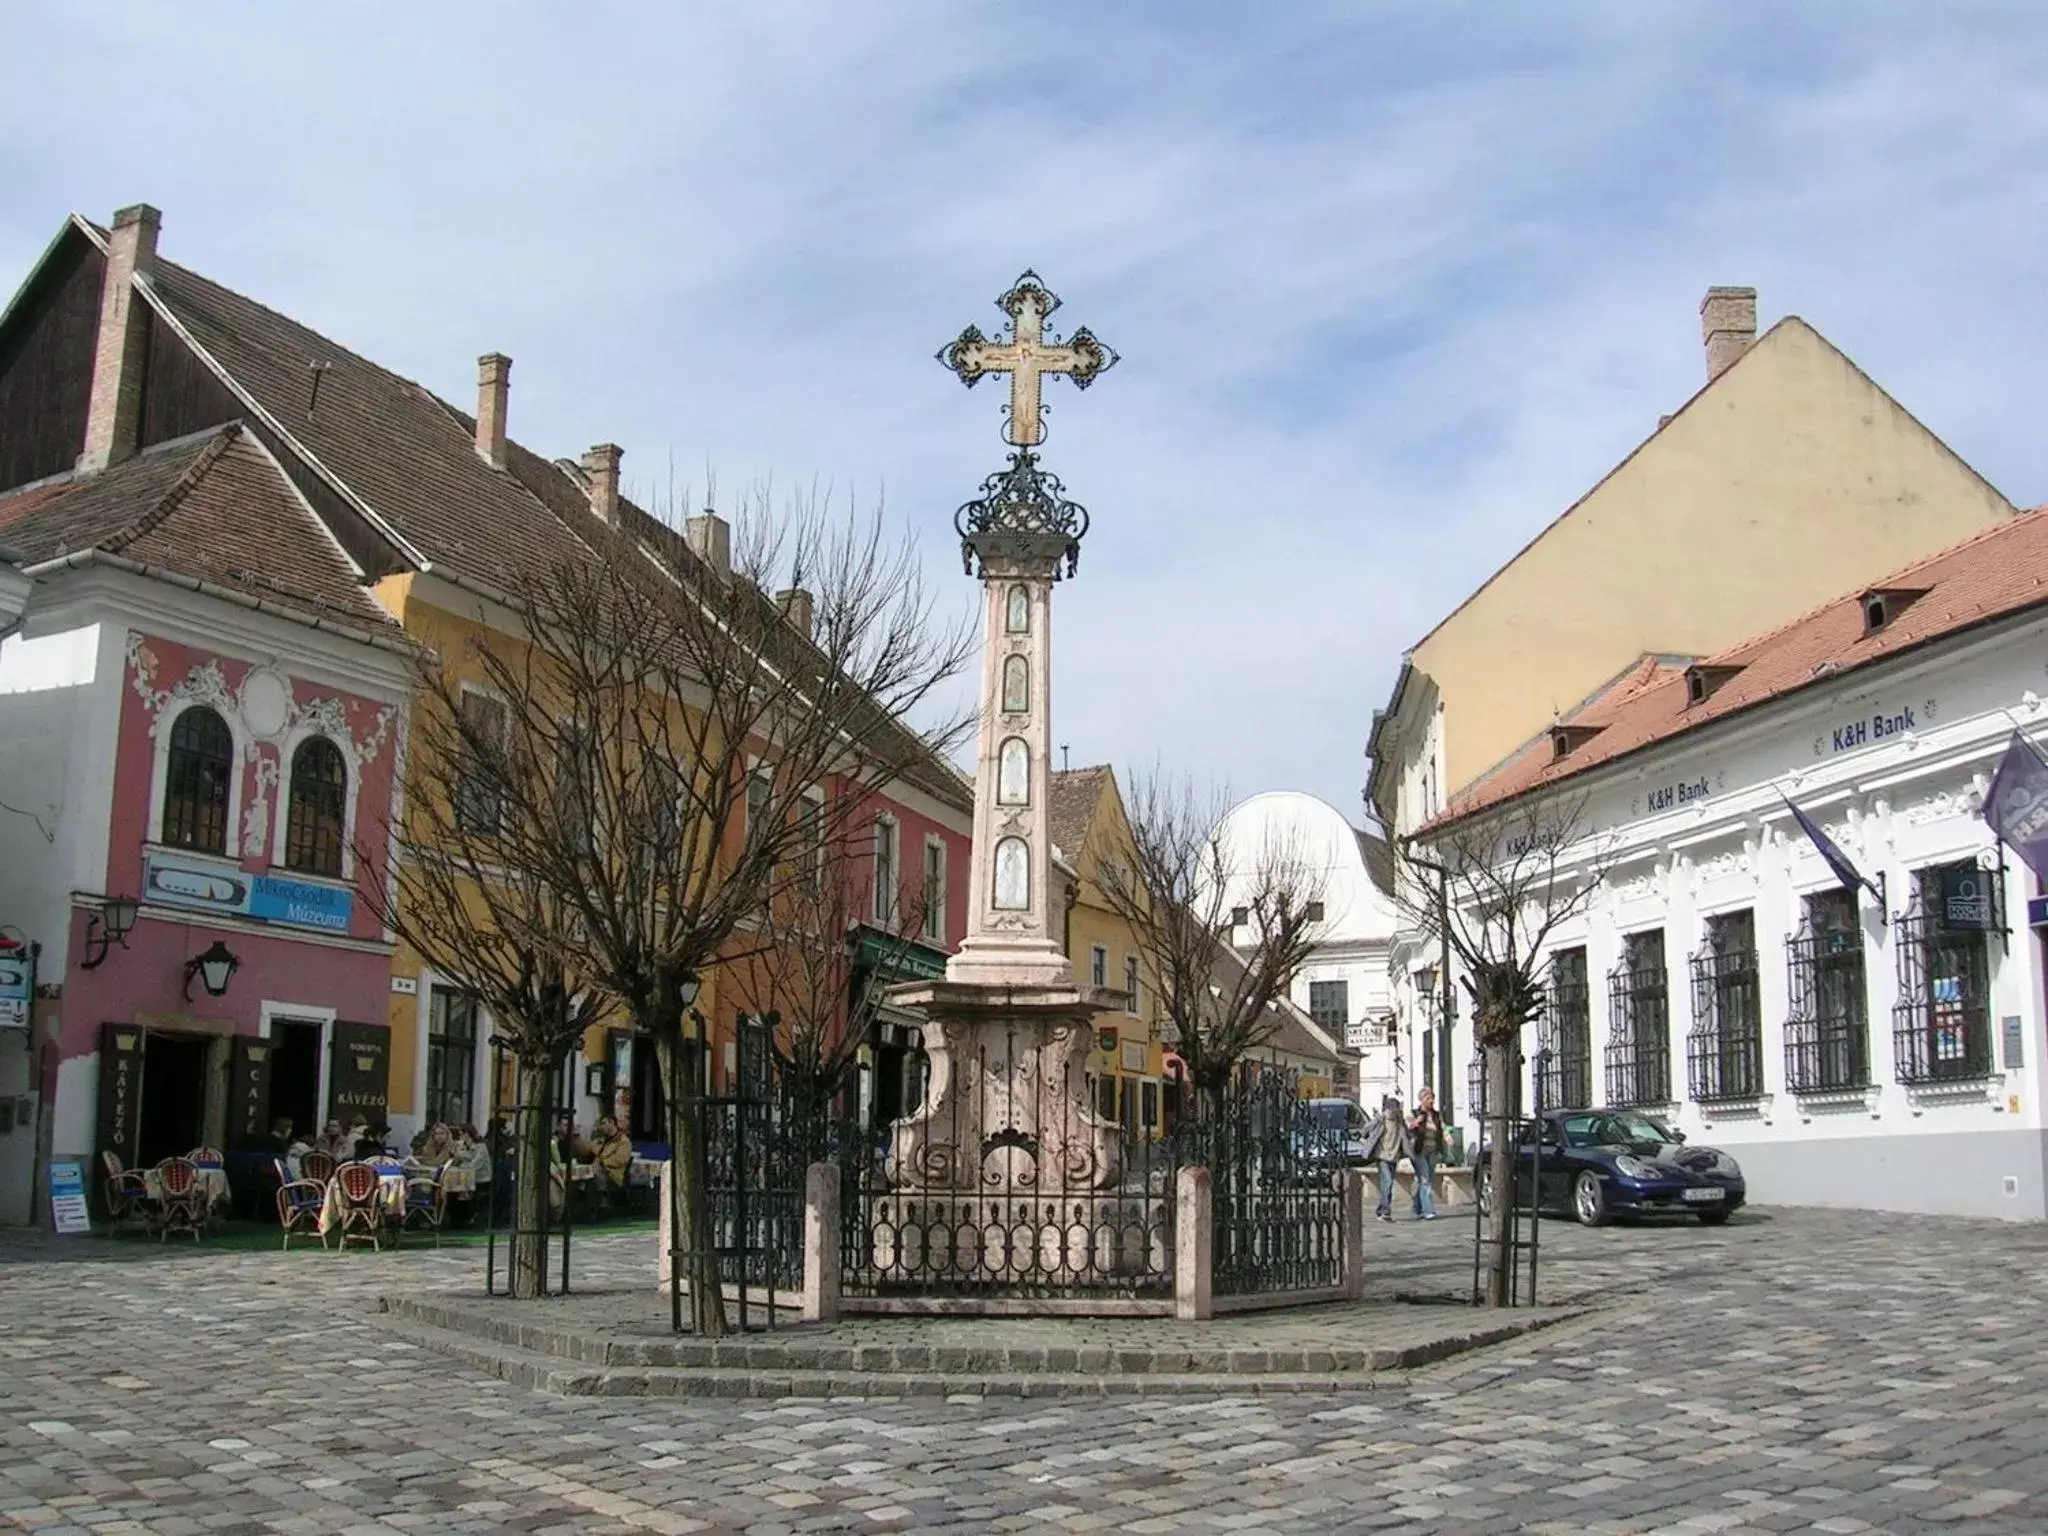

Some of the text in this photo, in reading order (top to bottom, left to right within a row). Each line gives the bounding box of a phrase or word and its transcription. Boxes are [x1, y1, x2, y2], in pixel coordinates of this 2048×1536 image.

[1833, 706, 1915, 752] K&H Bank
[1648, 776, 1709, 812] K&H Bank
[287, 903, 347, 928] Múzeuma
